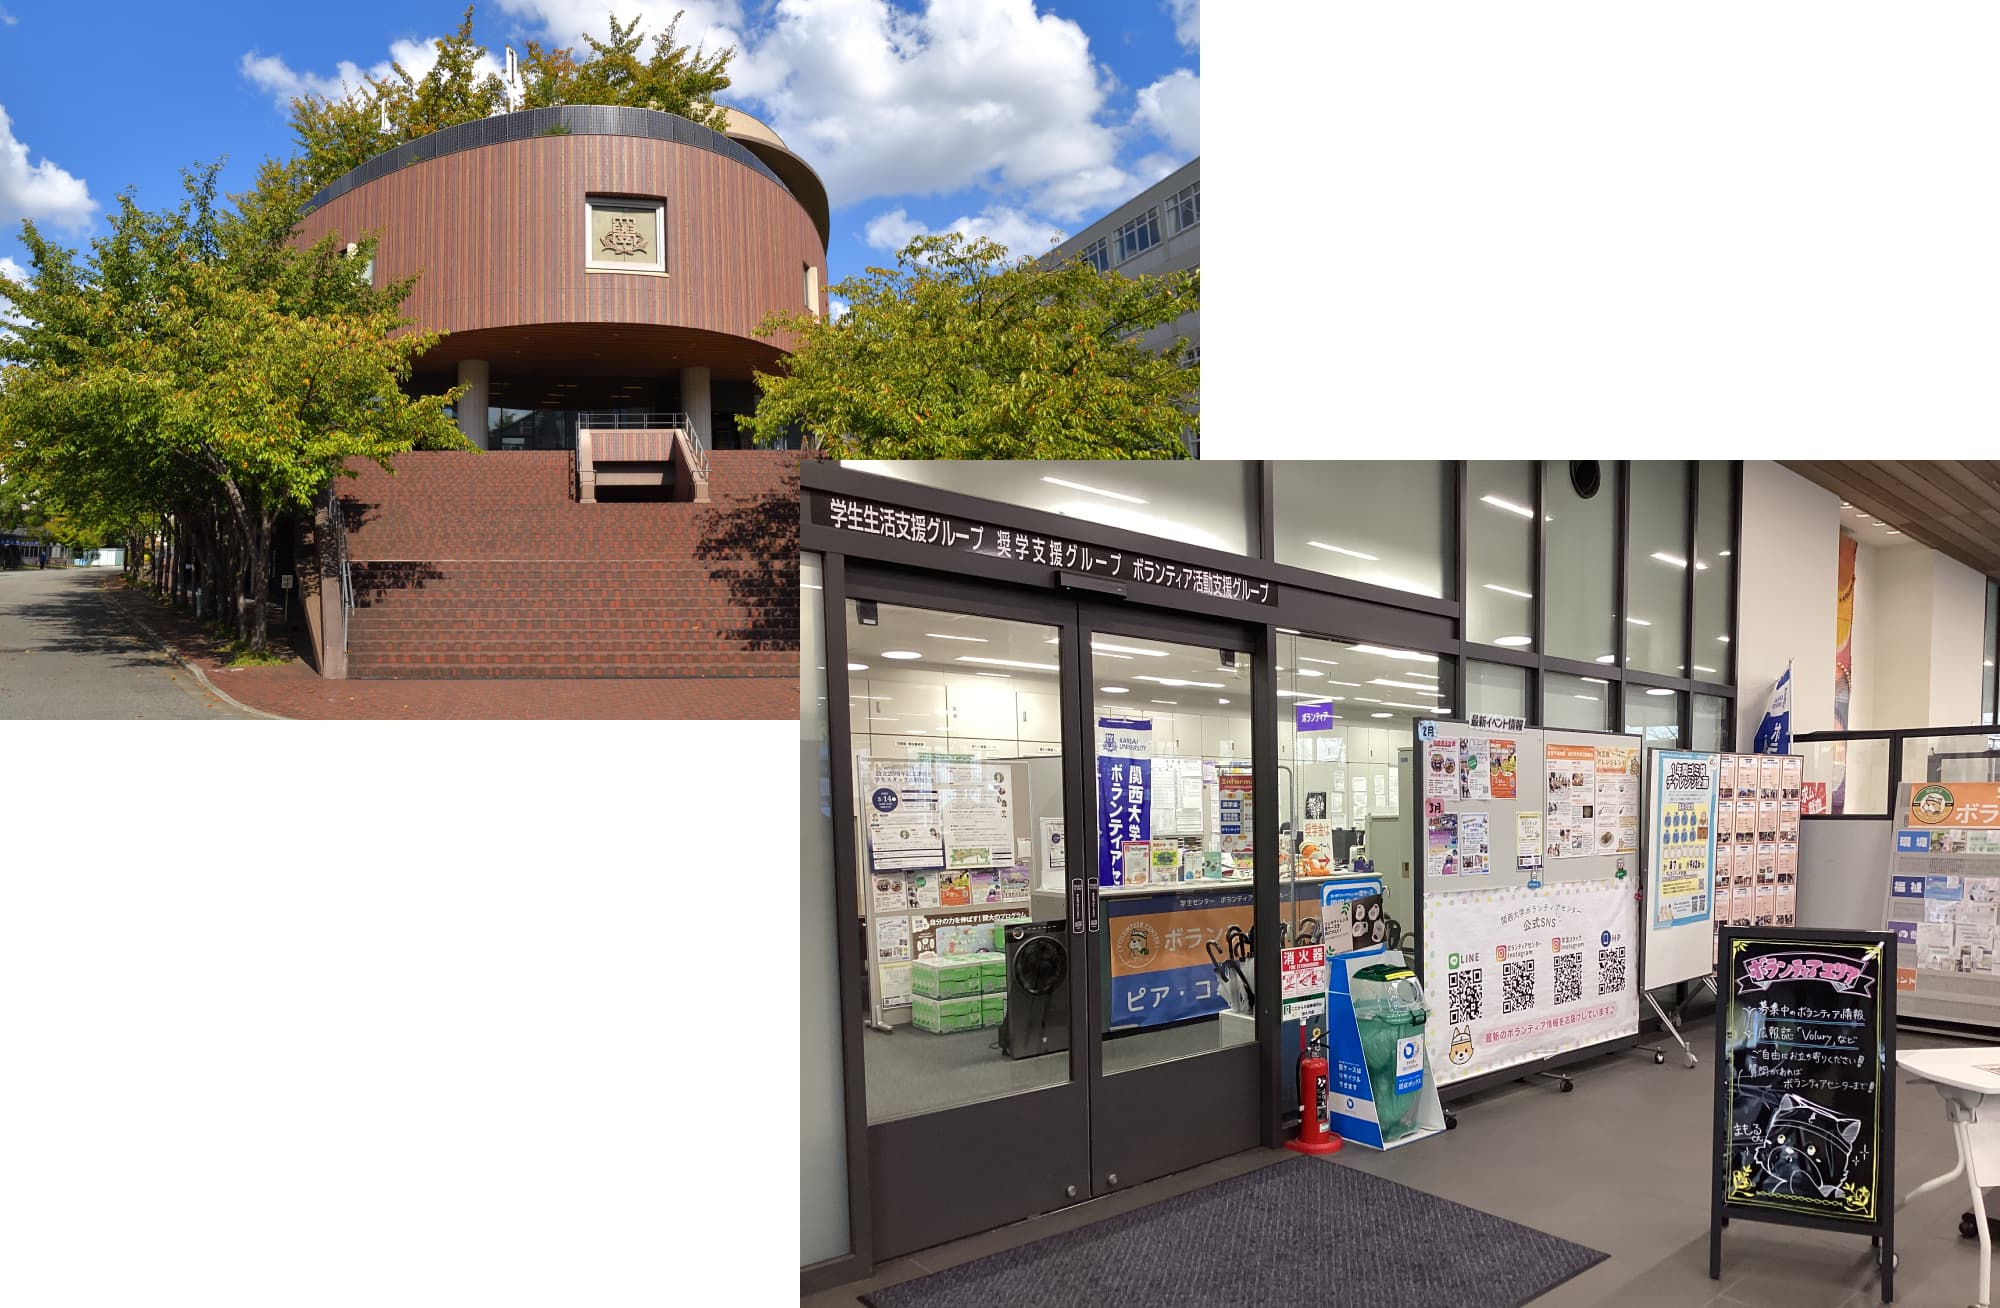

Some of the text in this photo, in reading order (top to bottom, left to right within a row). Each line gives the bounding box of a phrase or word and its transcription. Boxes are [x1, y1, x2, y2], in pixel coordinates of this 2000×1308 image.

[830, 498, 1269, 603] 学生生活支援グループ 奨学支援グループ ボランティア活動支援グループ
[1423, 726, 1434, 737] 2月
[1471, 715, 1524, 732] 最新イベント情報
[1128, 764, 1143, 842] 関西大学
[1428, 803, 1442, 814] 3月
[1955, 803, 2000, 824] ボラ
[1523, 917, 1556, 932] 公式SNS
[1612, 933, 1622, 942] HP
[1283, 947, 1324, 966] 消火器
[1460, 952, 1480, 964] LINE
[1748, 957, 1861, 985] ボランティアエリア
[1758, 1000, 1865, 1021] 募集中のボランティア情報
